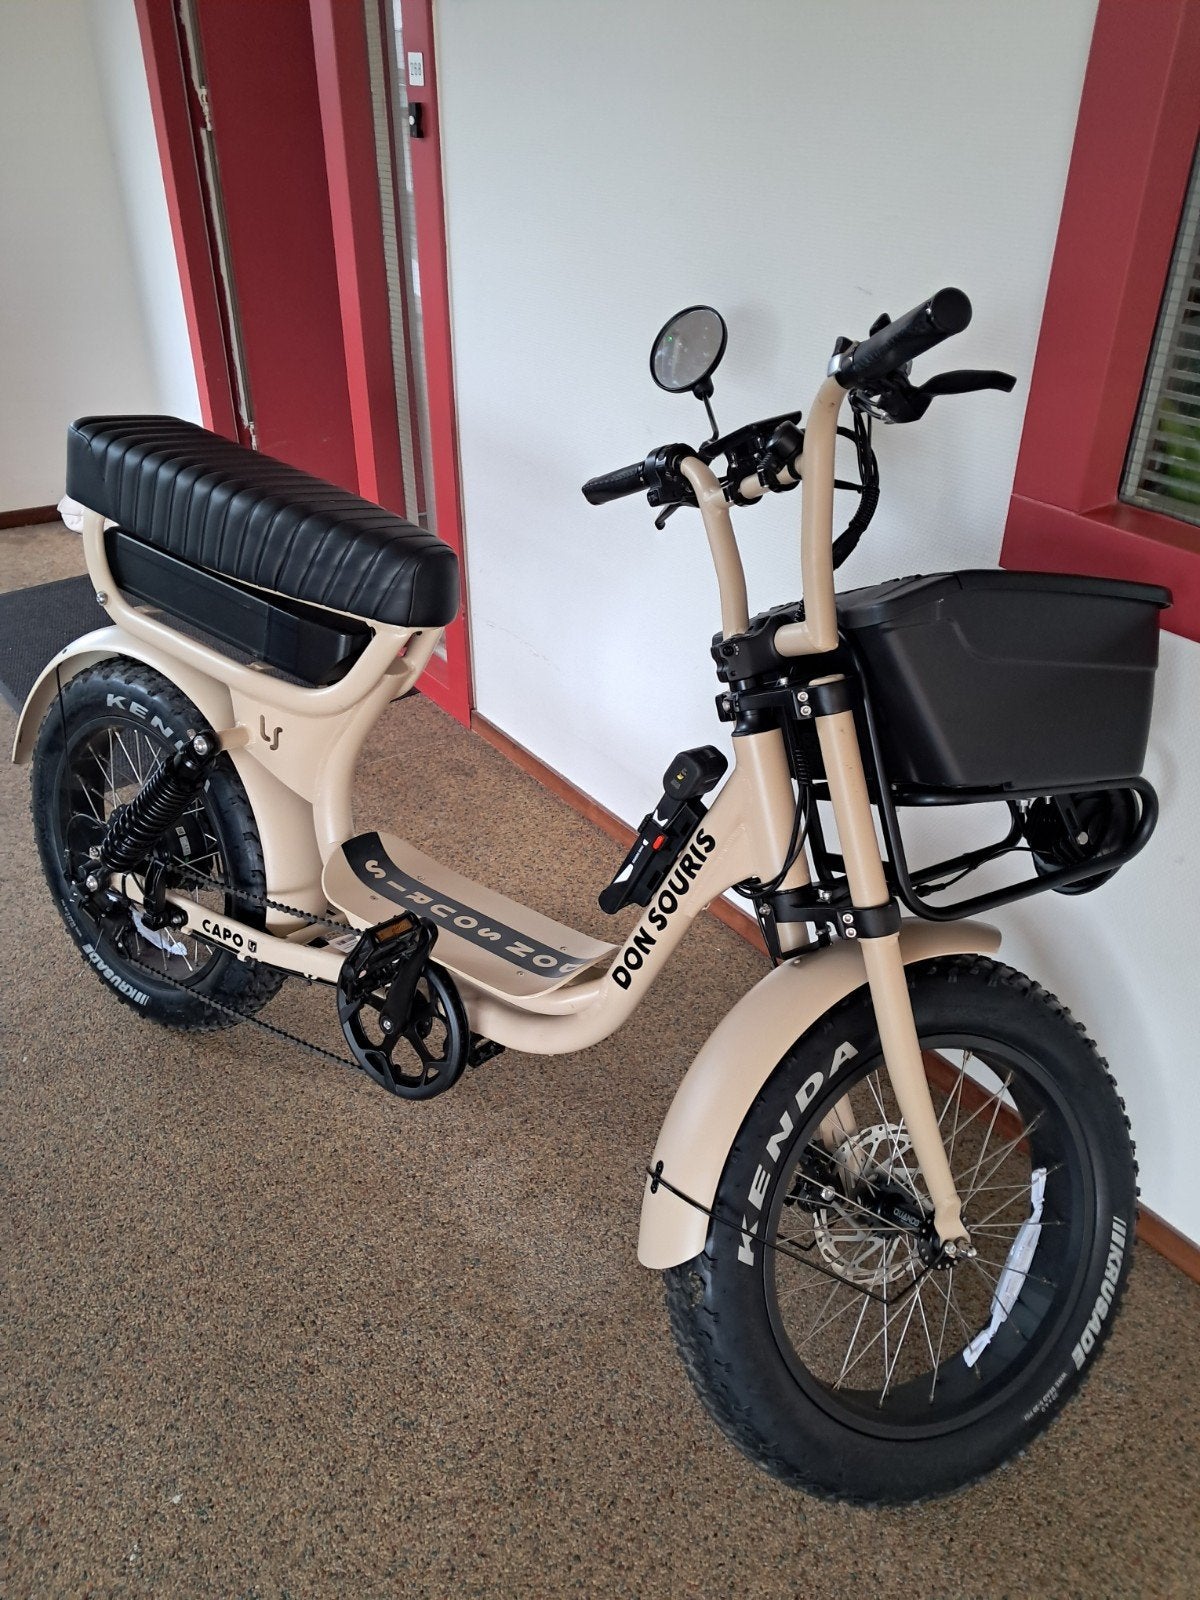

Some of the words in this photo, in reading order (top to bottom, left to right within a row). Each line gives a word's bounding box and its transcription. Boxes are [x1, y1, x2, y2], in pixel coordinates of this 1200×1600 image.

[107, 693, 184, 751] KEN
[202, 919, 244, 947] CAPO
[364, 859, 502, 941] SOURIS
[611, 926, 657, 990] DON
[648, 828, 716, 931] SOURIS
[81, 943, 138, 999] KRUSADE
[737, 1041, 859, 1267] KENDA
[1071, 1242, 1124, 1371] KRUSADE
